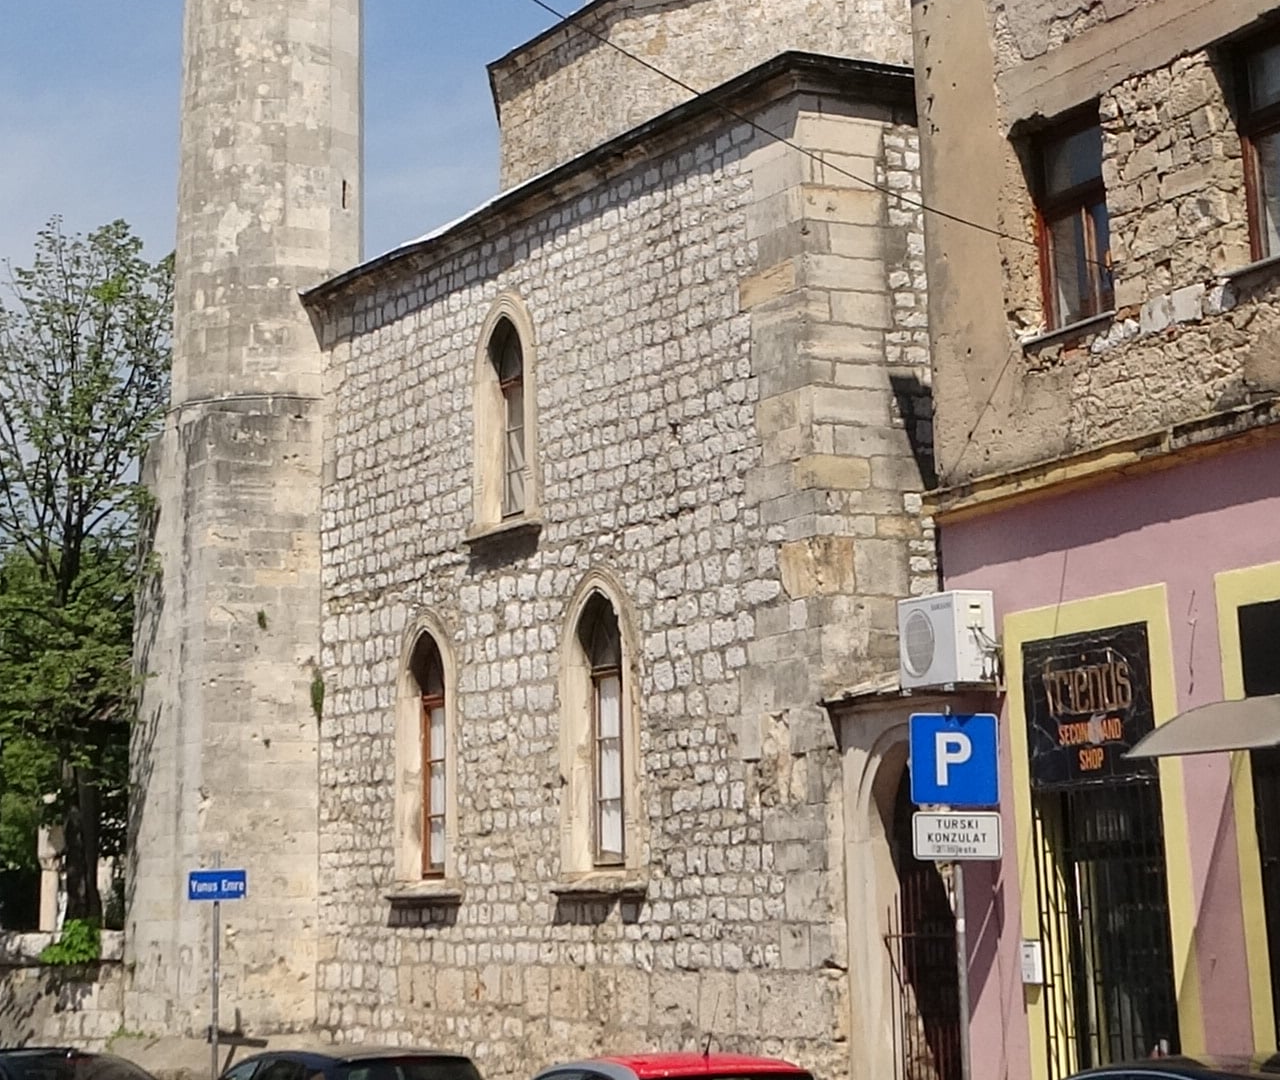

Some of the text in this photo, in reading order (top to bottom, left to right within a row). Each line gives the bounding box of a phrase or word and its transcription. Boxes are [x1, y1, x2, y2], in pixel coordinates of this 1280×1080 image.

[935, 732, 972, 786] P
[1079, 747, 1104, 771] SHOP
[936, 819, 979, 830] TURSKI
[927, 832, 987, 843] KONZULAT
[190, 879, 244, 893] Yunus Emre
